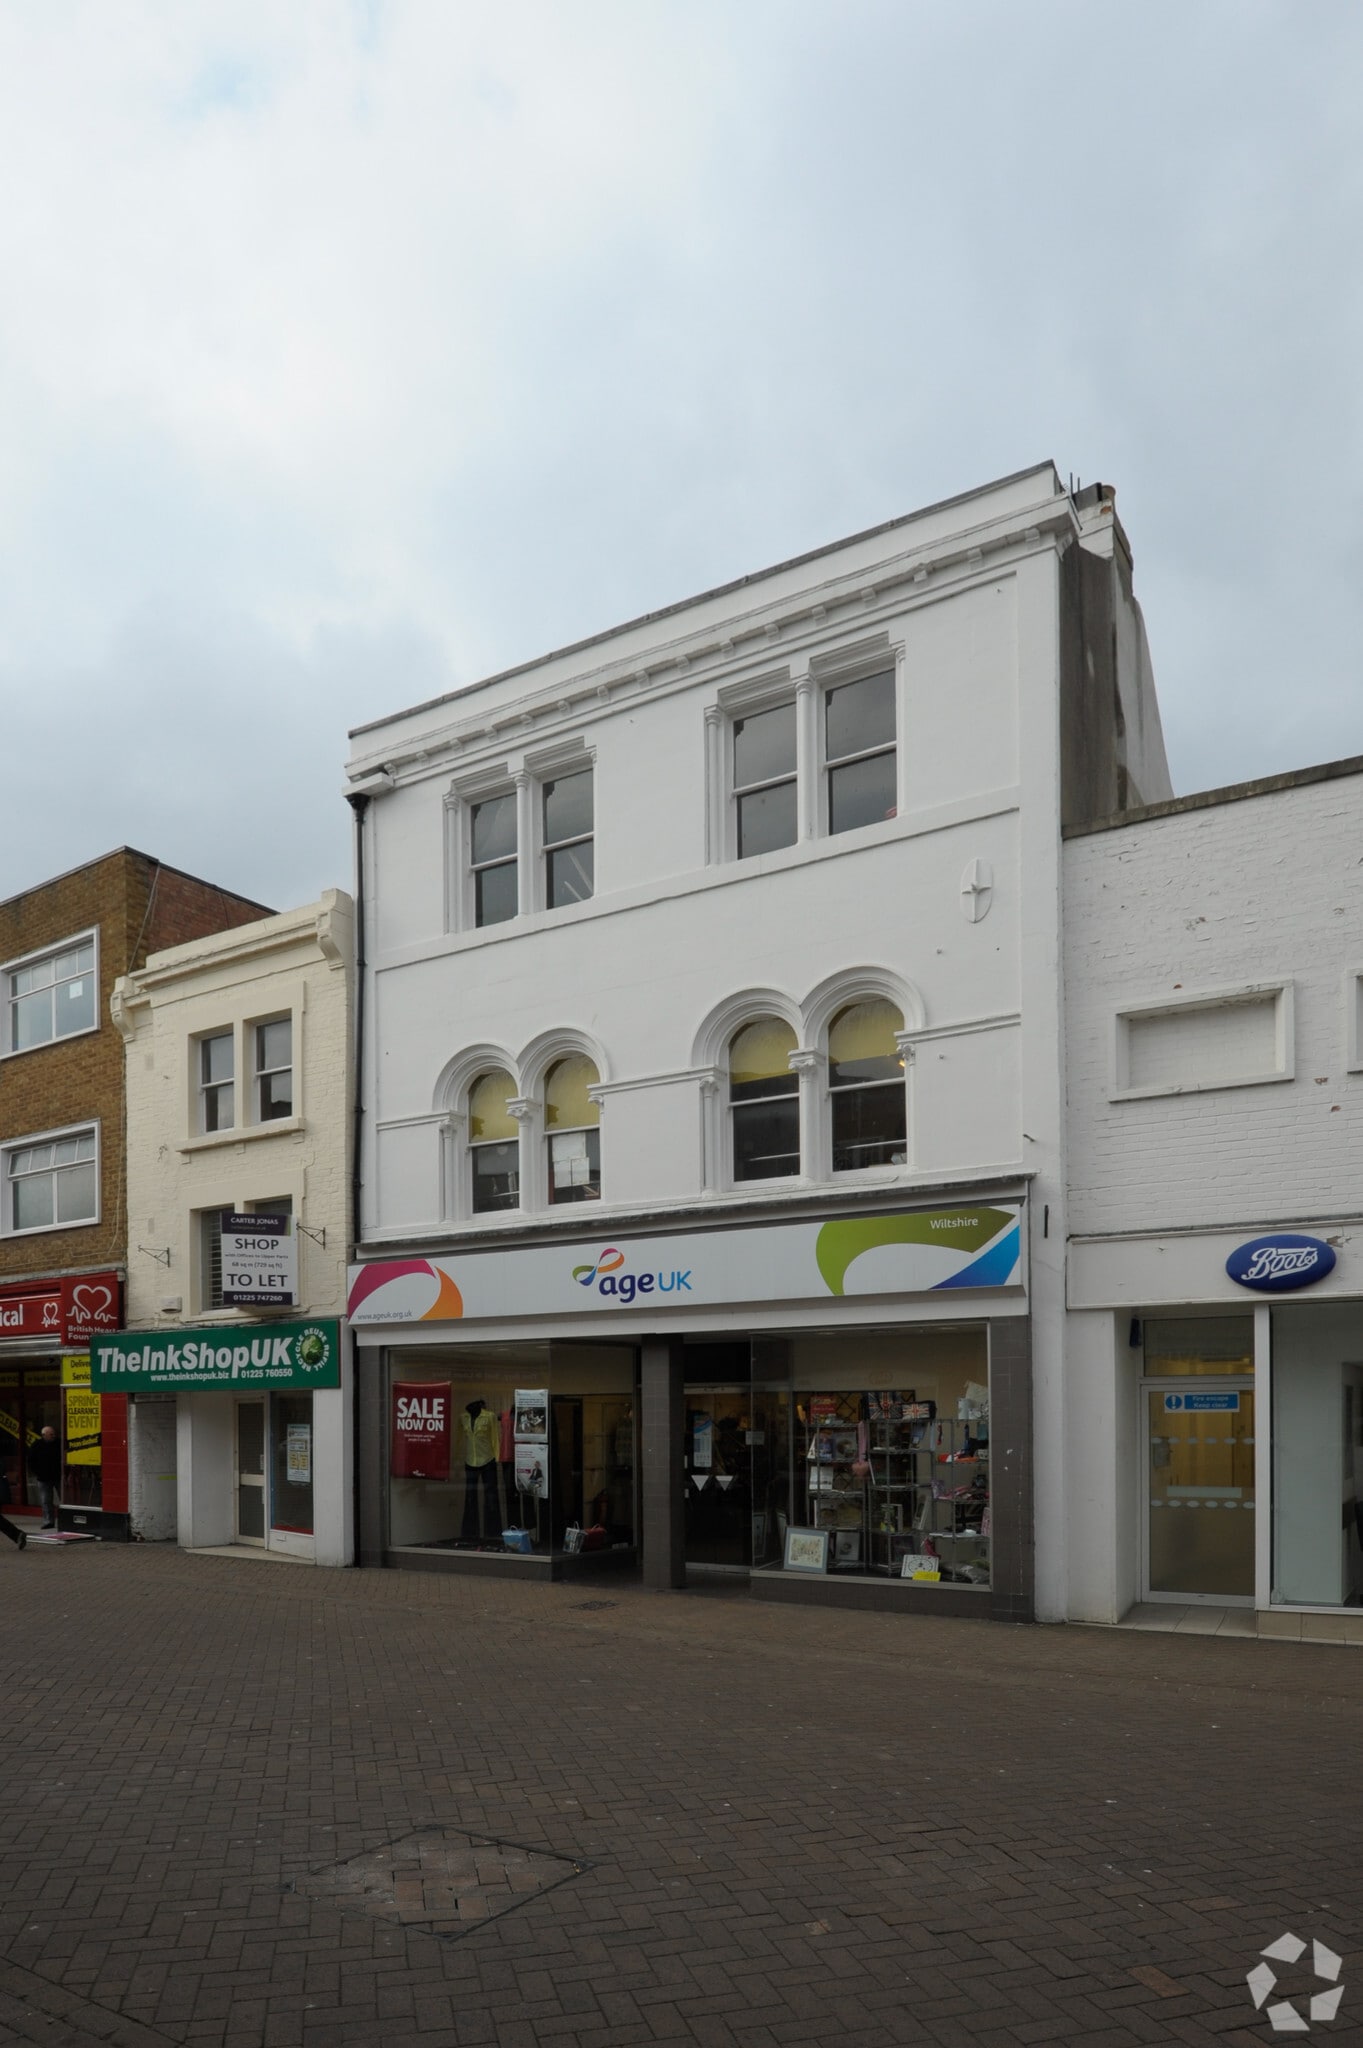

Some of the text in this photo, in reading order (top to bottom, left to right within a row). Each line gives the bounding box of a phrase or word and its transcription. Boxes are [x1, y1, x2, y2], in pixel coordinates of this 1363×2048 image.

[930, 1217, 978, 1229] Wiltshire
[235, 1238, 279, 1250] SHOP
[1241, 1246, 1318, 1281] Boots
[227, 1273, 288, 1287] TO LET
[357, 1310, 412, 1321] www.ageuk.org.uk
[68, 1325, 93, 1333] British
[304, 1327, 327, 1343] REUSE
[97, 1337, 293, 1378] TheInkShopUK
[295, 1334, 312, 1372] RECYCLE
[312, 1344, 330, 1372] REFILL
[241, 1369, 264, 1378] 01225
[265, 1368, 293, 1377] 760550
[68, 1395, 99, 1407] SPRING
[397, 1397, 445, 1419] SALE
[69, 1415, 99, 1428] EVENT
[397, 1419, 444, 1431] NOW ON
